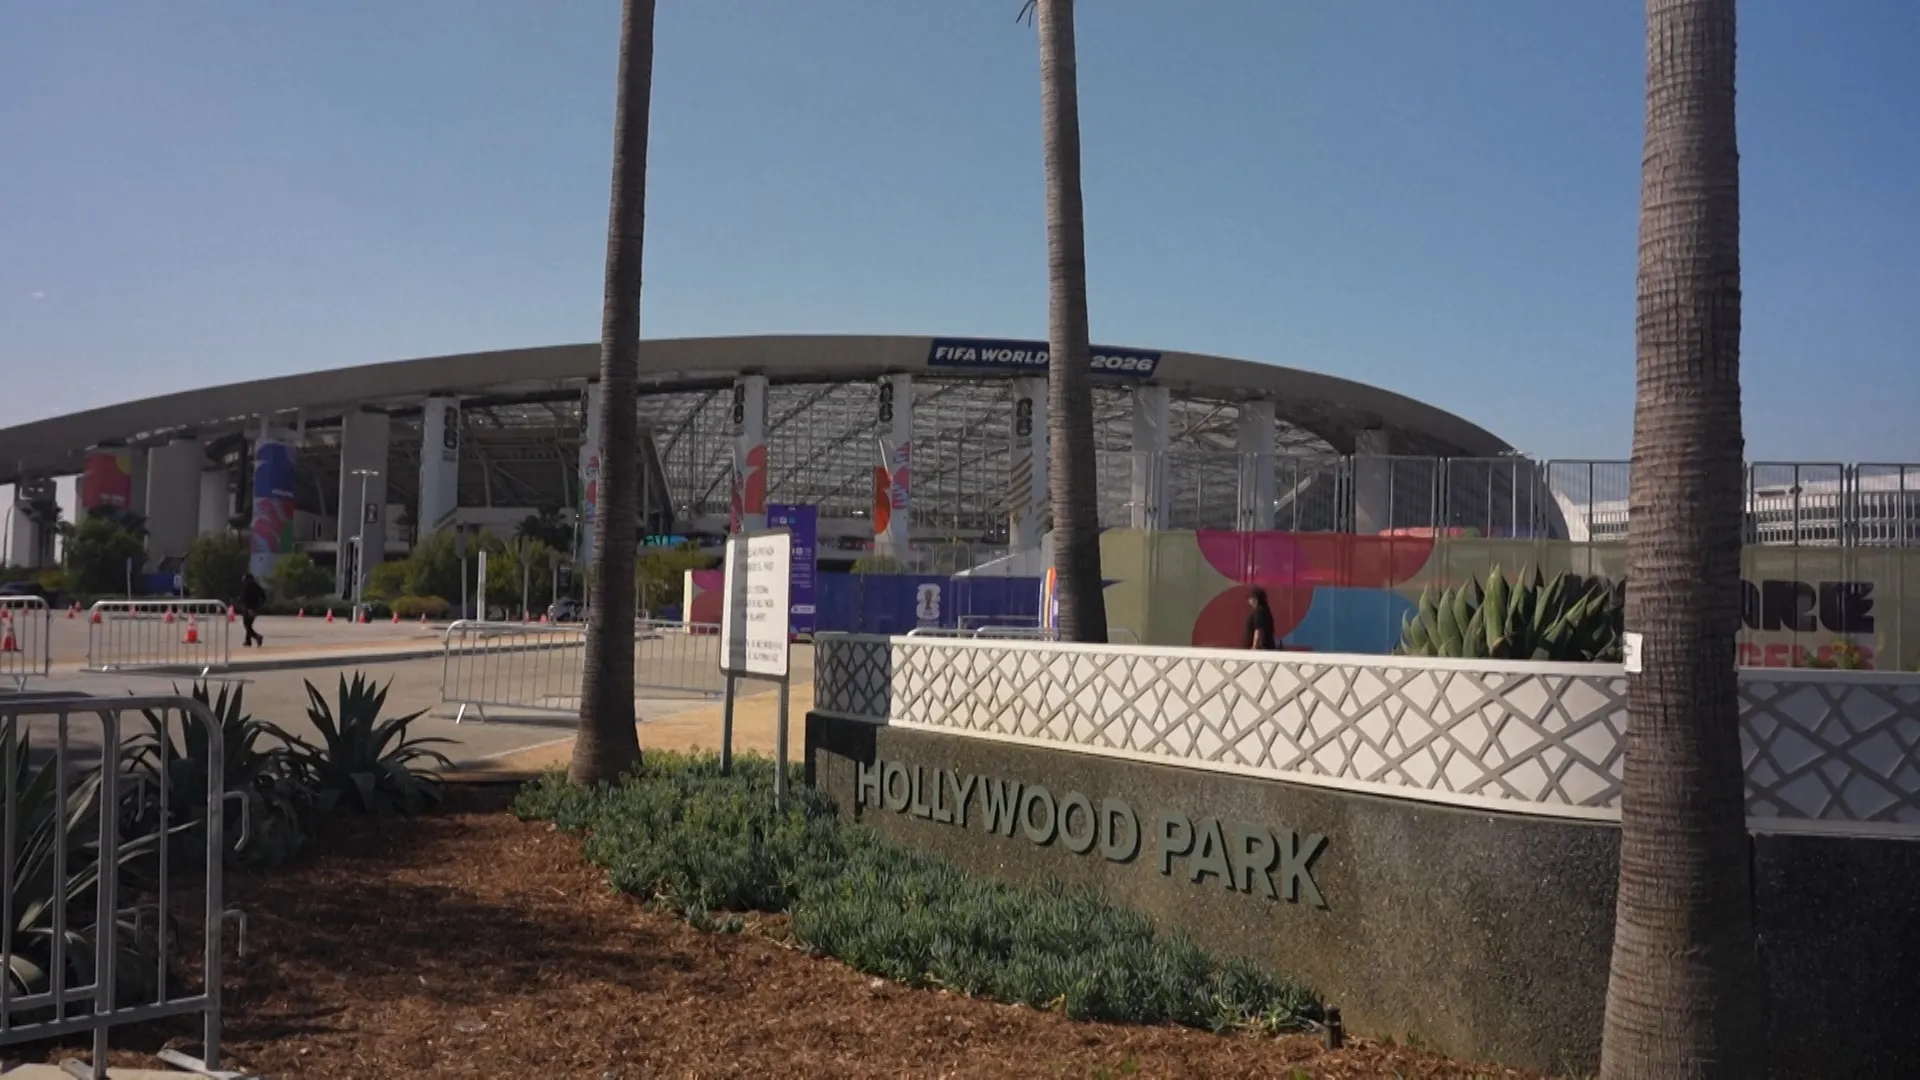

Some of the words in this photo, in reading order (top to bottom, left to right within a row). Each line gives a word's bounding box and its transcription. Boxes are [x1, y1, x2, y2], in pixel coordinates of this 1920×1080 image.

[935, 347, 977, 361] FIFA
[981, 347, 1049, 365] WORLD
[1090, 354, 1153, 371] 2026
[856, 760, 1141, 864] HOLLYWOOD
[1157, 809, 1329, 910] PARK
